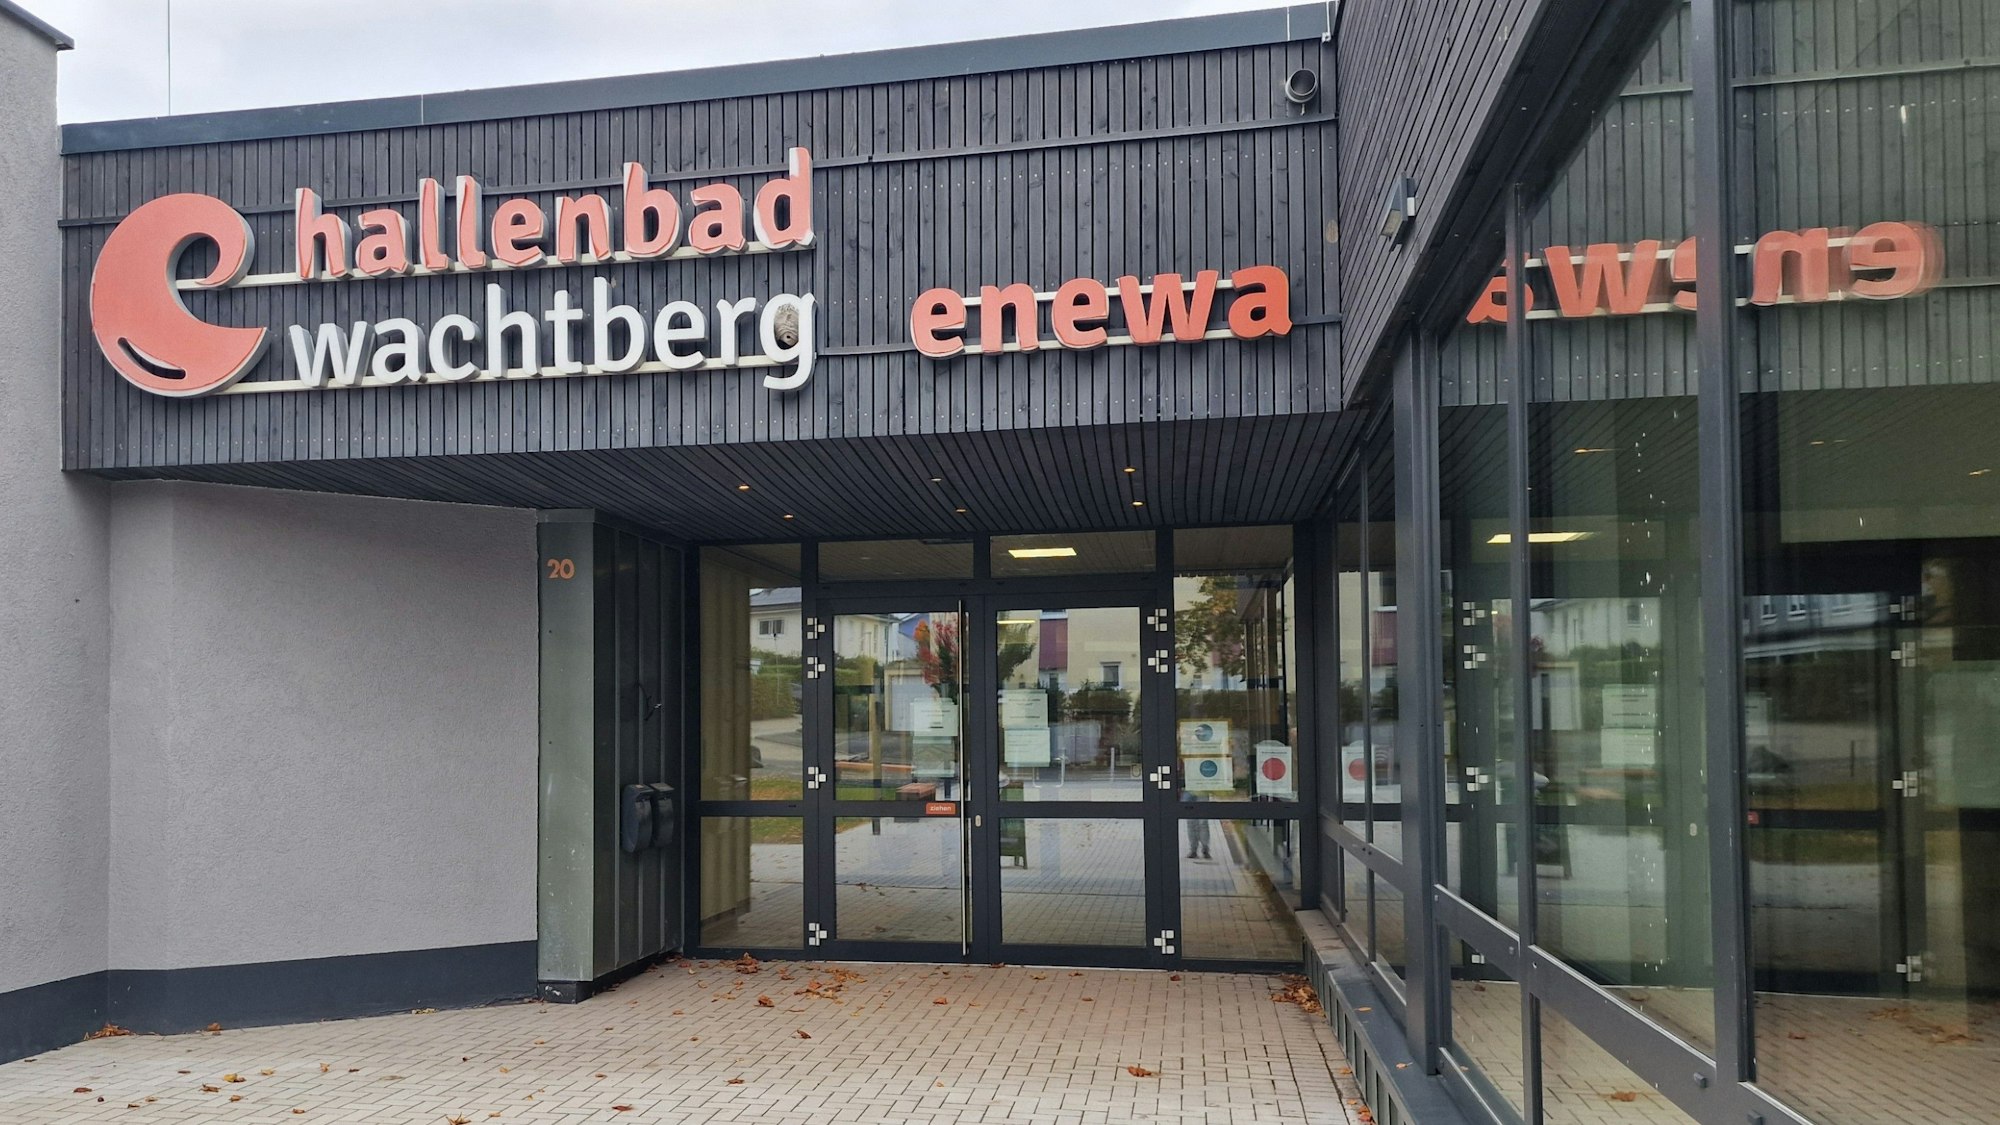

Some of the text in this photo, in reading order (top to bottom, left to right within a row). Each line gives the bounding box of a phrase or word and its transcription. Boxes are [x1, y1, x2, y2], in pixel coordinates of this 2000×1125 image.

[295, 147, 814, 278] hallenbad
[288, 277, 818, 390] wachtberg
[910, 263, 1293, 357] enewa
[546, 558, 575, 579] 20
